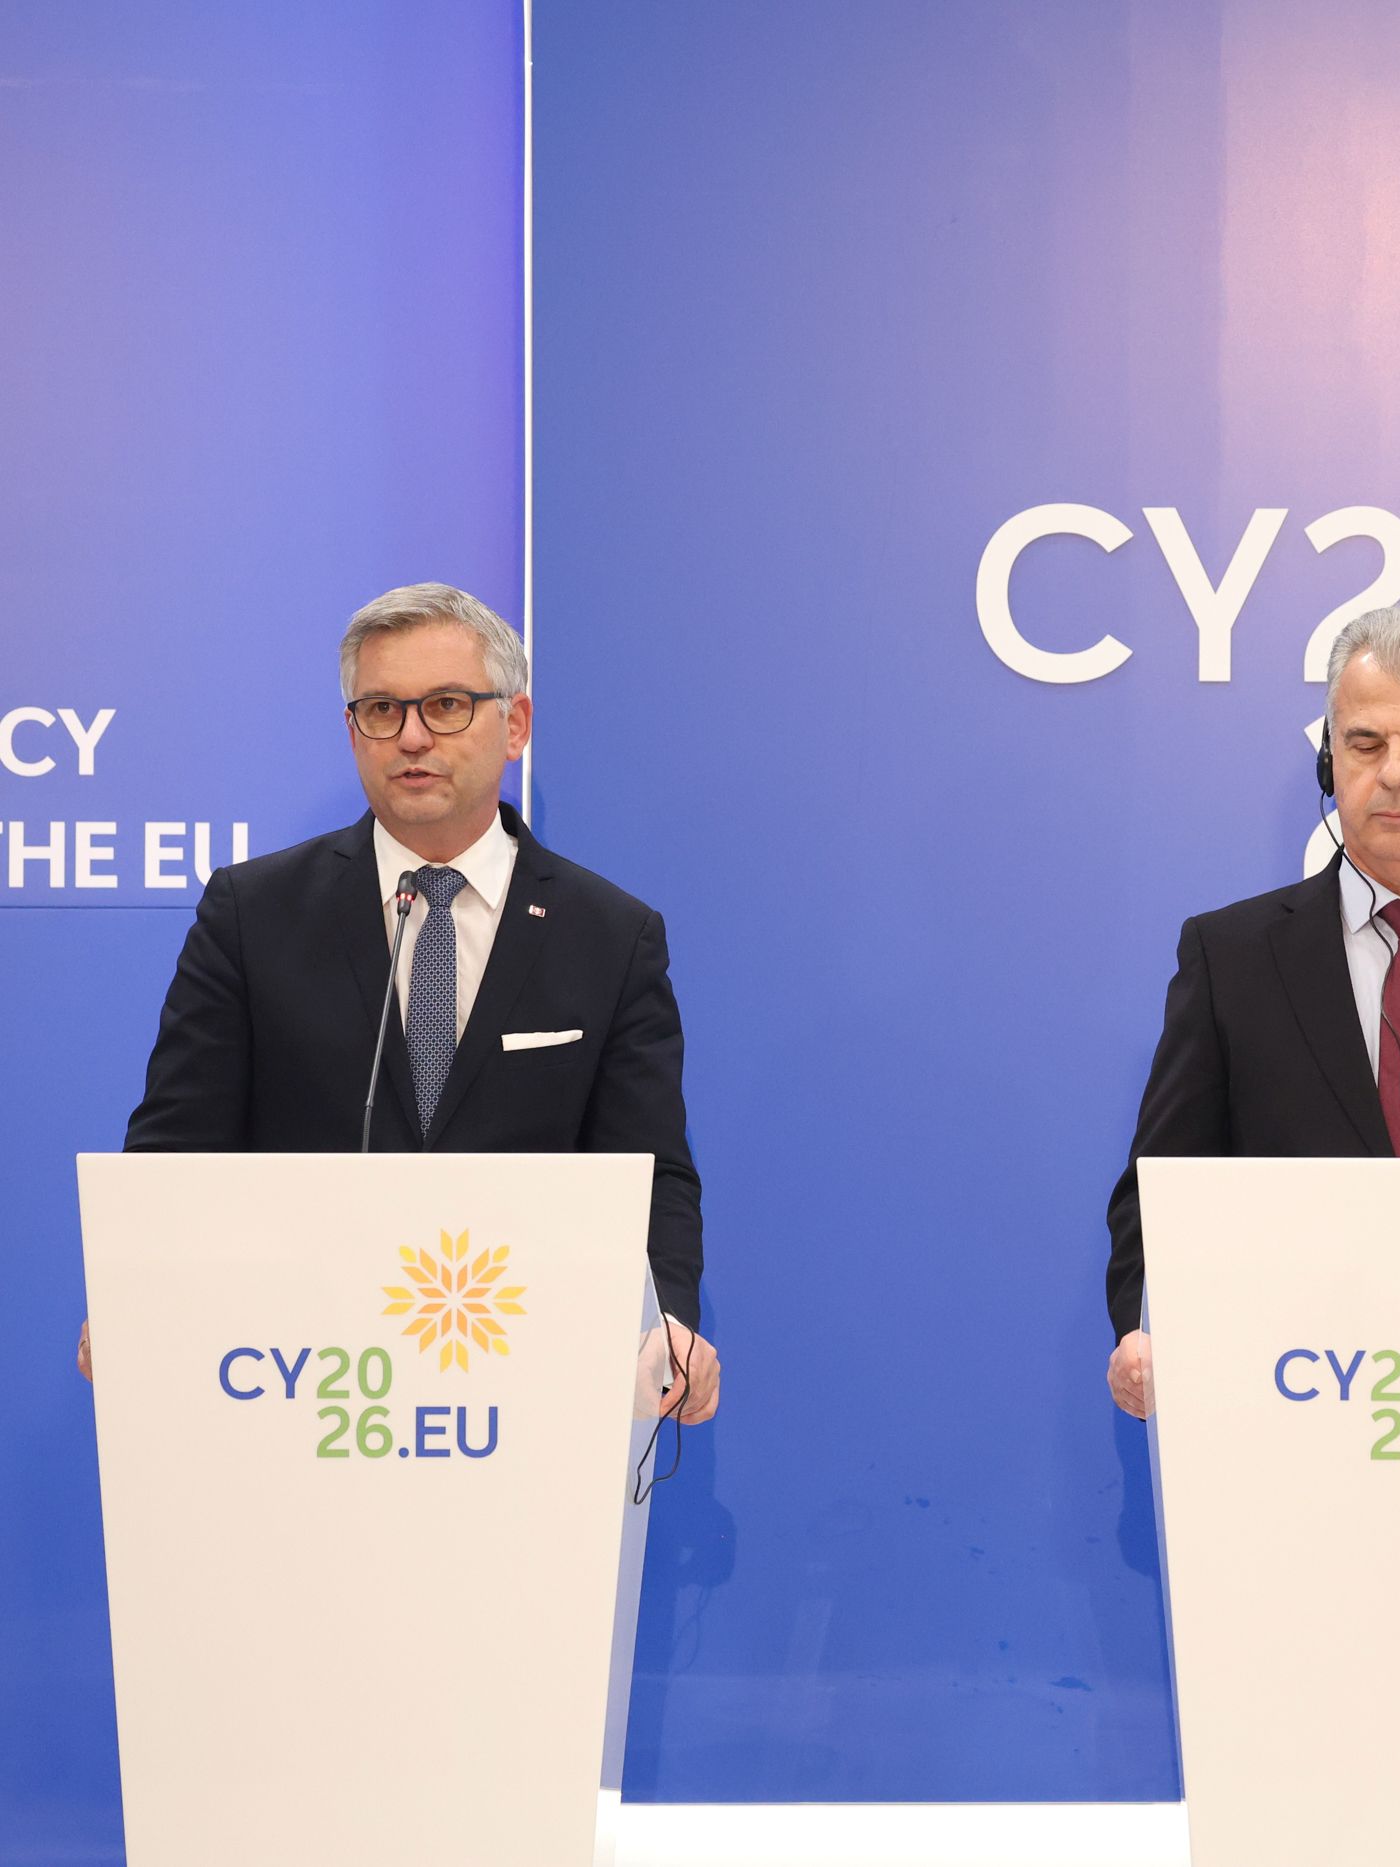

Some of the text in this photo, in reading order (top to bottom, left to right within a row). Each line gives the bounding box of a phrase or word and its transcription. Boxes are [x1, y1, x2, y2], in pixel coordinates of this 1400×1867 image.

[0, 821, 249, 889] HE EU
[218, 1346, 392, 1401] CY20
[316, 1405, 499, 1459] 26.EU
